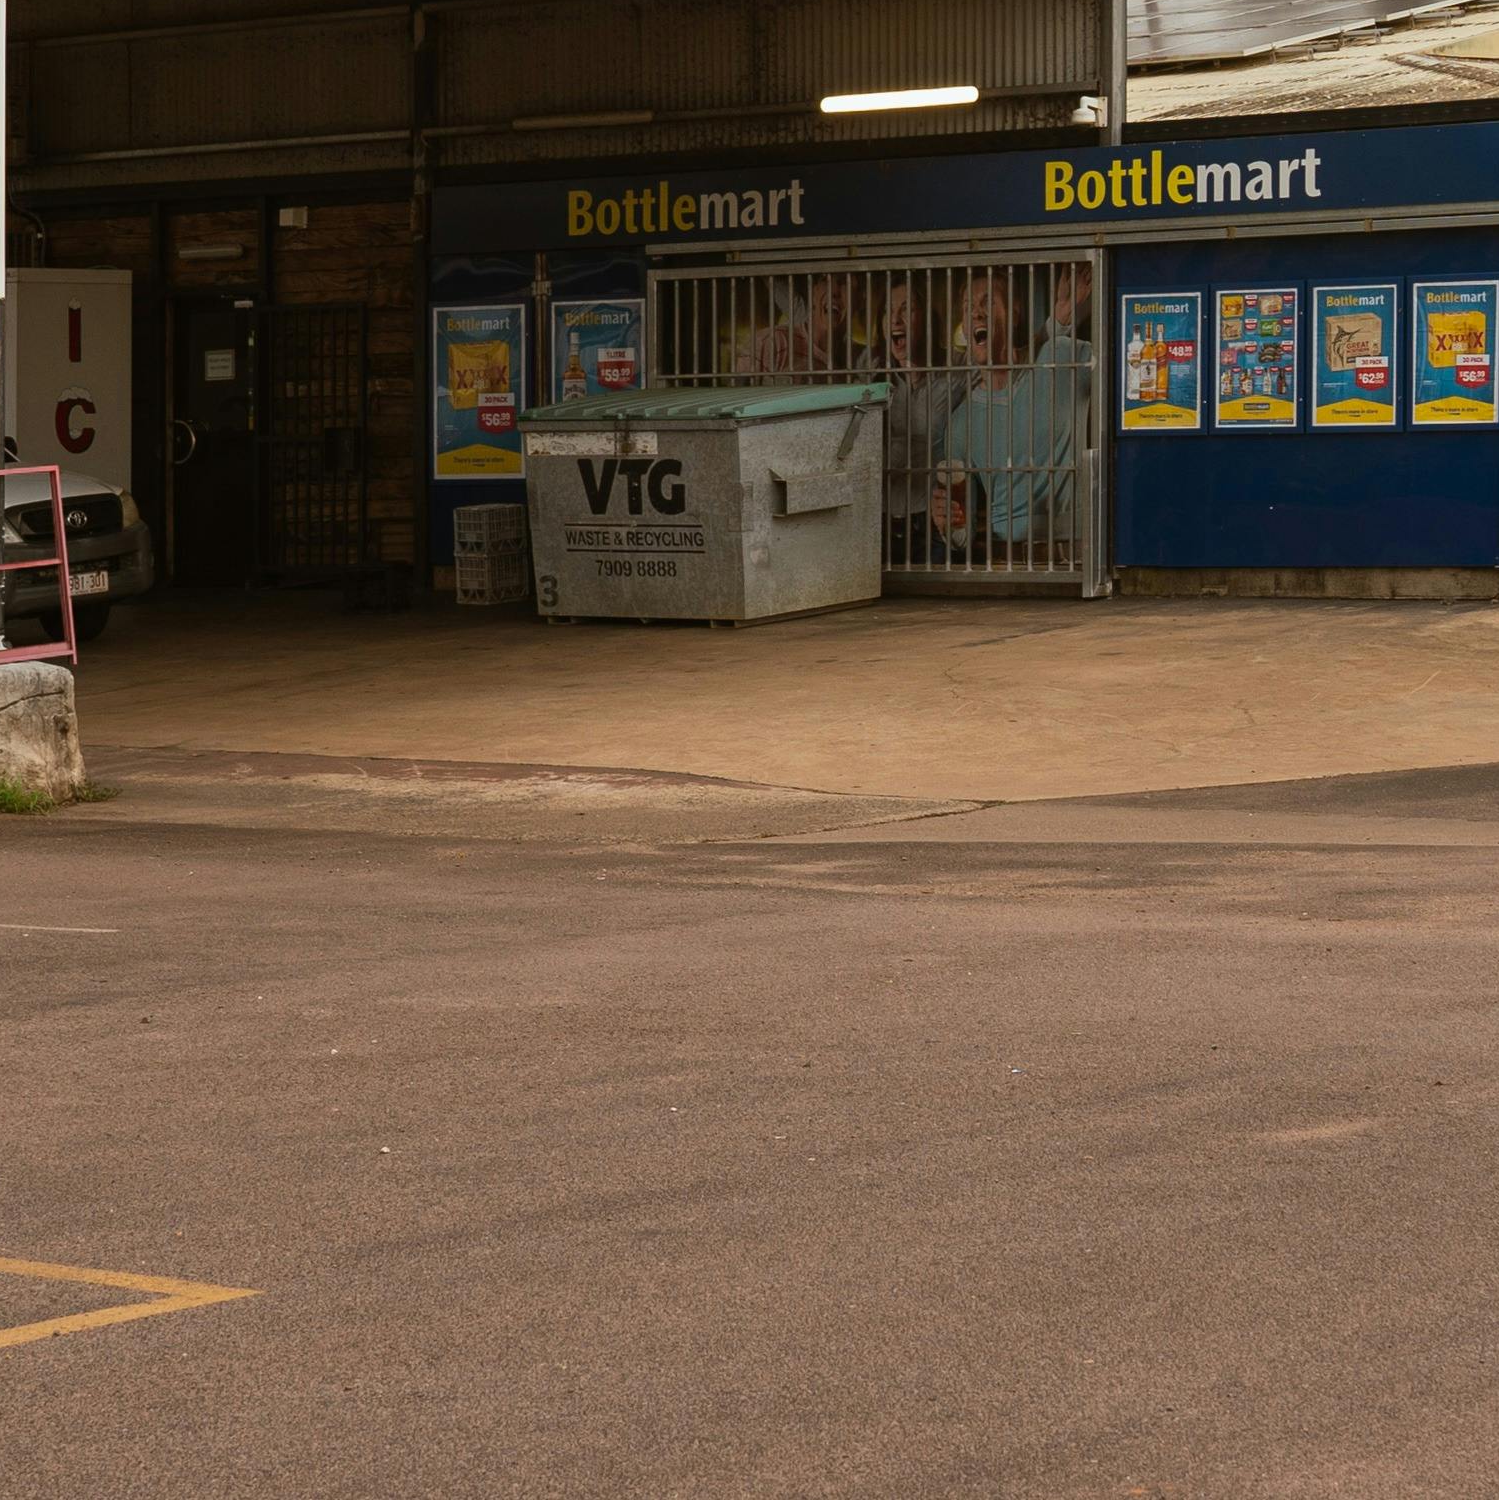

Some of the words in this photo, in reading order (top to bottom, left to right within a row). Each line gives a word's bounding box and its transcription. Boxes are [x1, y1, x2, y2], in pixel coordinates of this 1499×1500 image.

[1045, 148, 1322, 211] Bottlemart
[568, 179, 805, 236] Bottlemart
[1326, 294, 1385, 307] Bottlemart
[1426, 291, 1487, 304] Bottlemart
[1133, 302, 1190, 314] Bottlemart
[446, 316, 511, 332] Bottlemart
[564, 310, 631, 326] Bottlemart
[577, 458, 686, 515] VTG
[565, 530, 611, 546] WASTE
[613, 530, 623, 546] &
[626, 530, 705, 547] RECYCLING
[596, 560, 633, 577] 7909
[636, 560, 678, 577] 8888
[538, 575, 559, 607] 3
